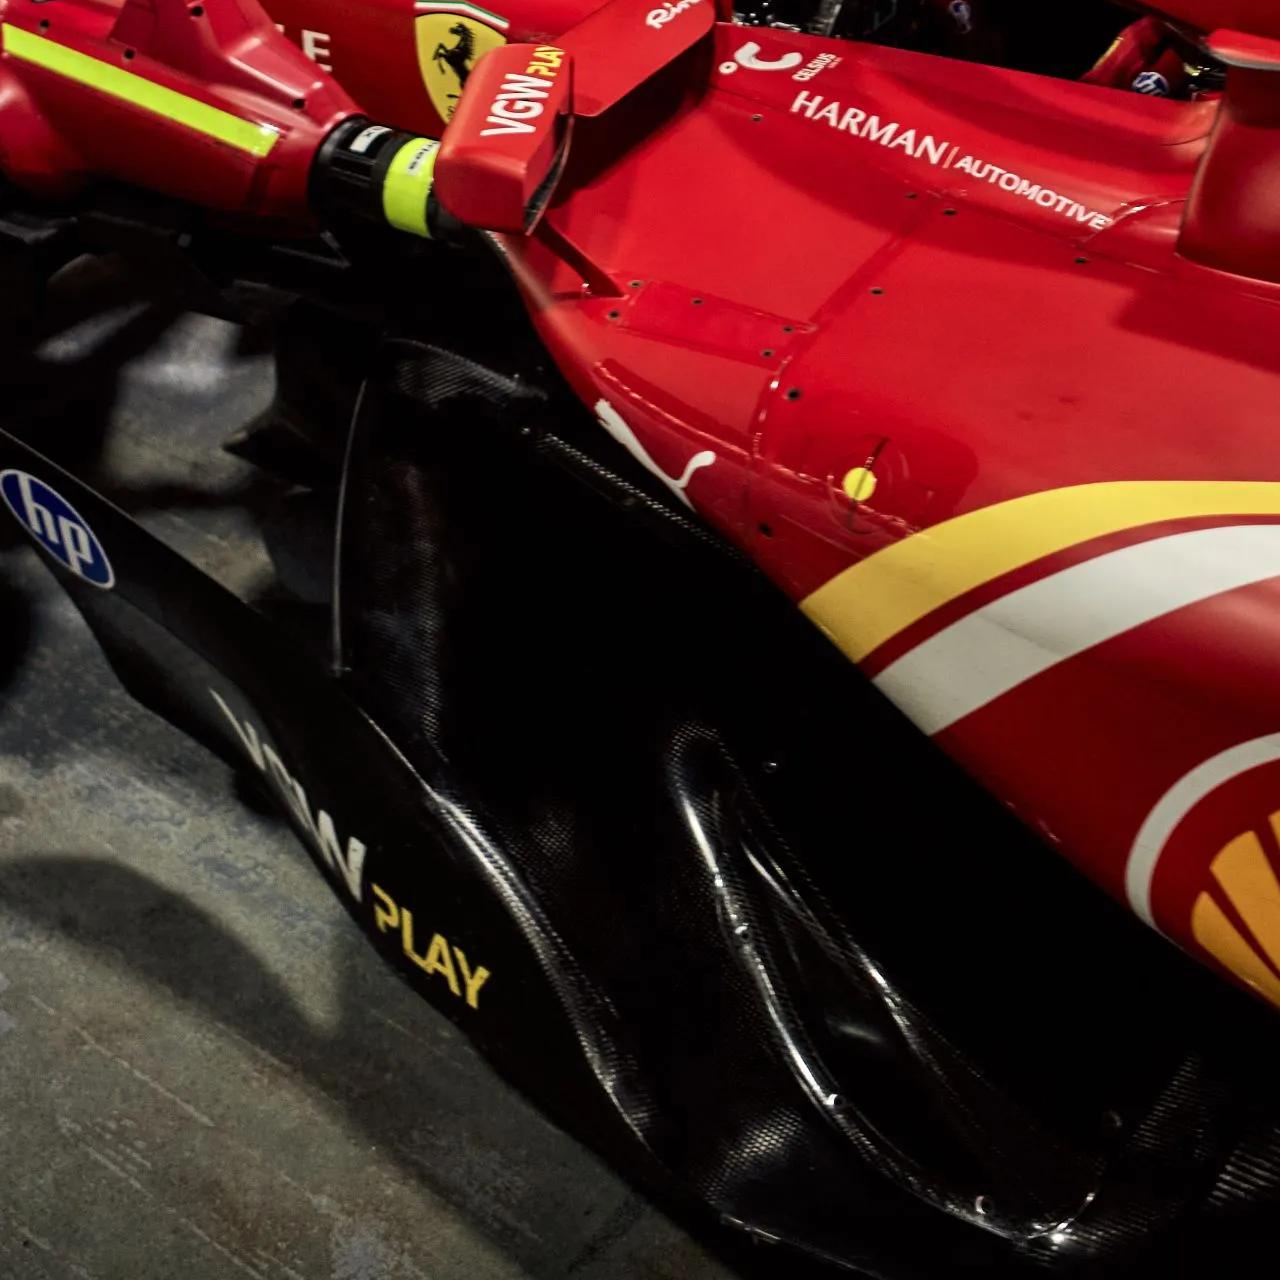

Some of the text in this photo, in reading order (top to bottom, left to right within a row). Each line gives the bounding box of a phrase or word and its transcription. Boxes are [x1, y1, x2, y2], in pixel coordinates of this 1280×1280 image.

[479, 45, 566, 137] VGW PLAY
[790, 90, 1114, 231] HARMAN AUTOMOTIVE
[9, 472, 102, 580] hp
[370, 880, 491, 1011] PLAY
